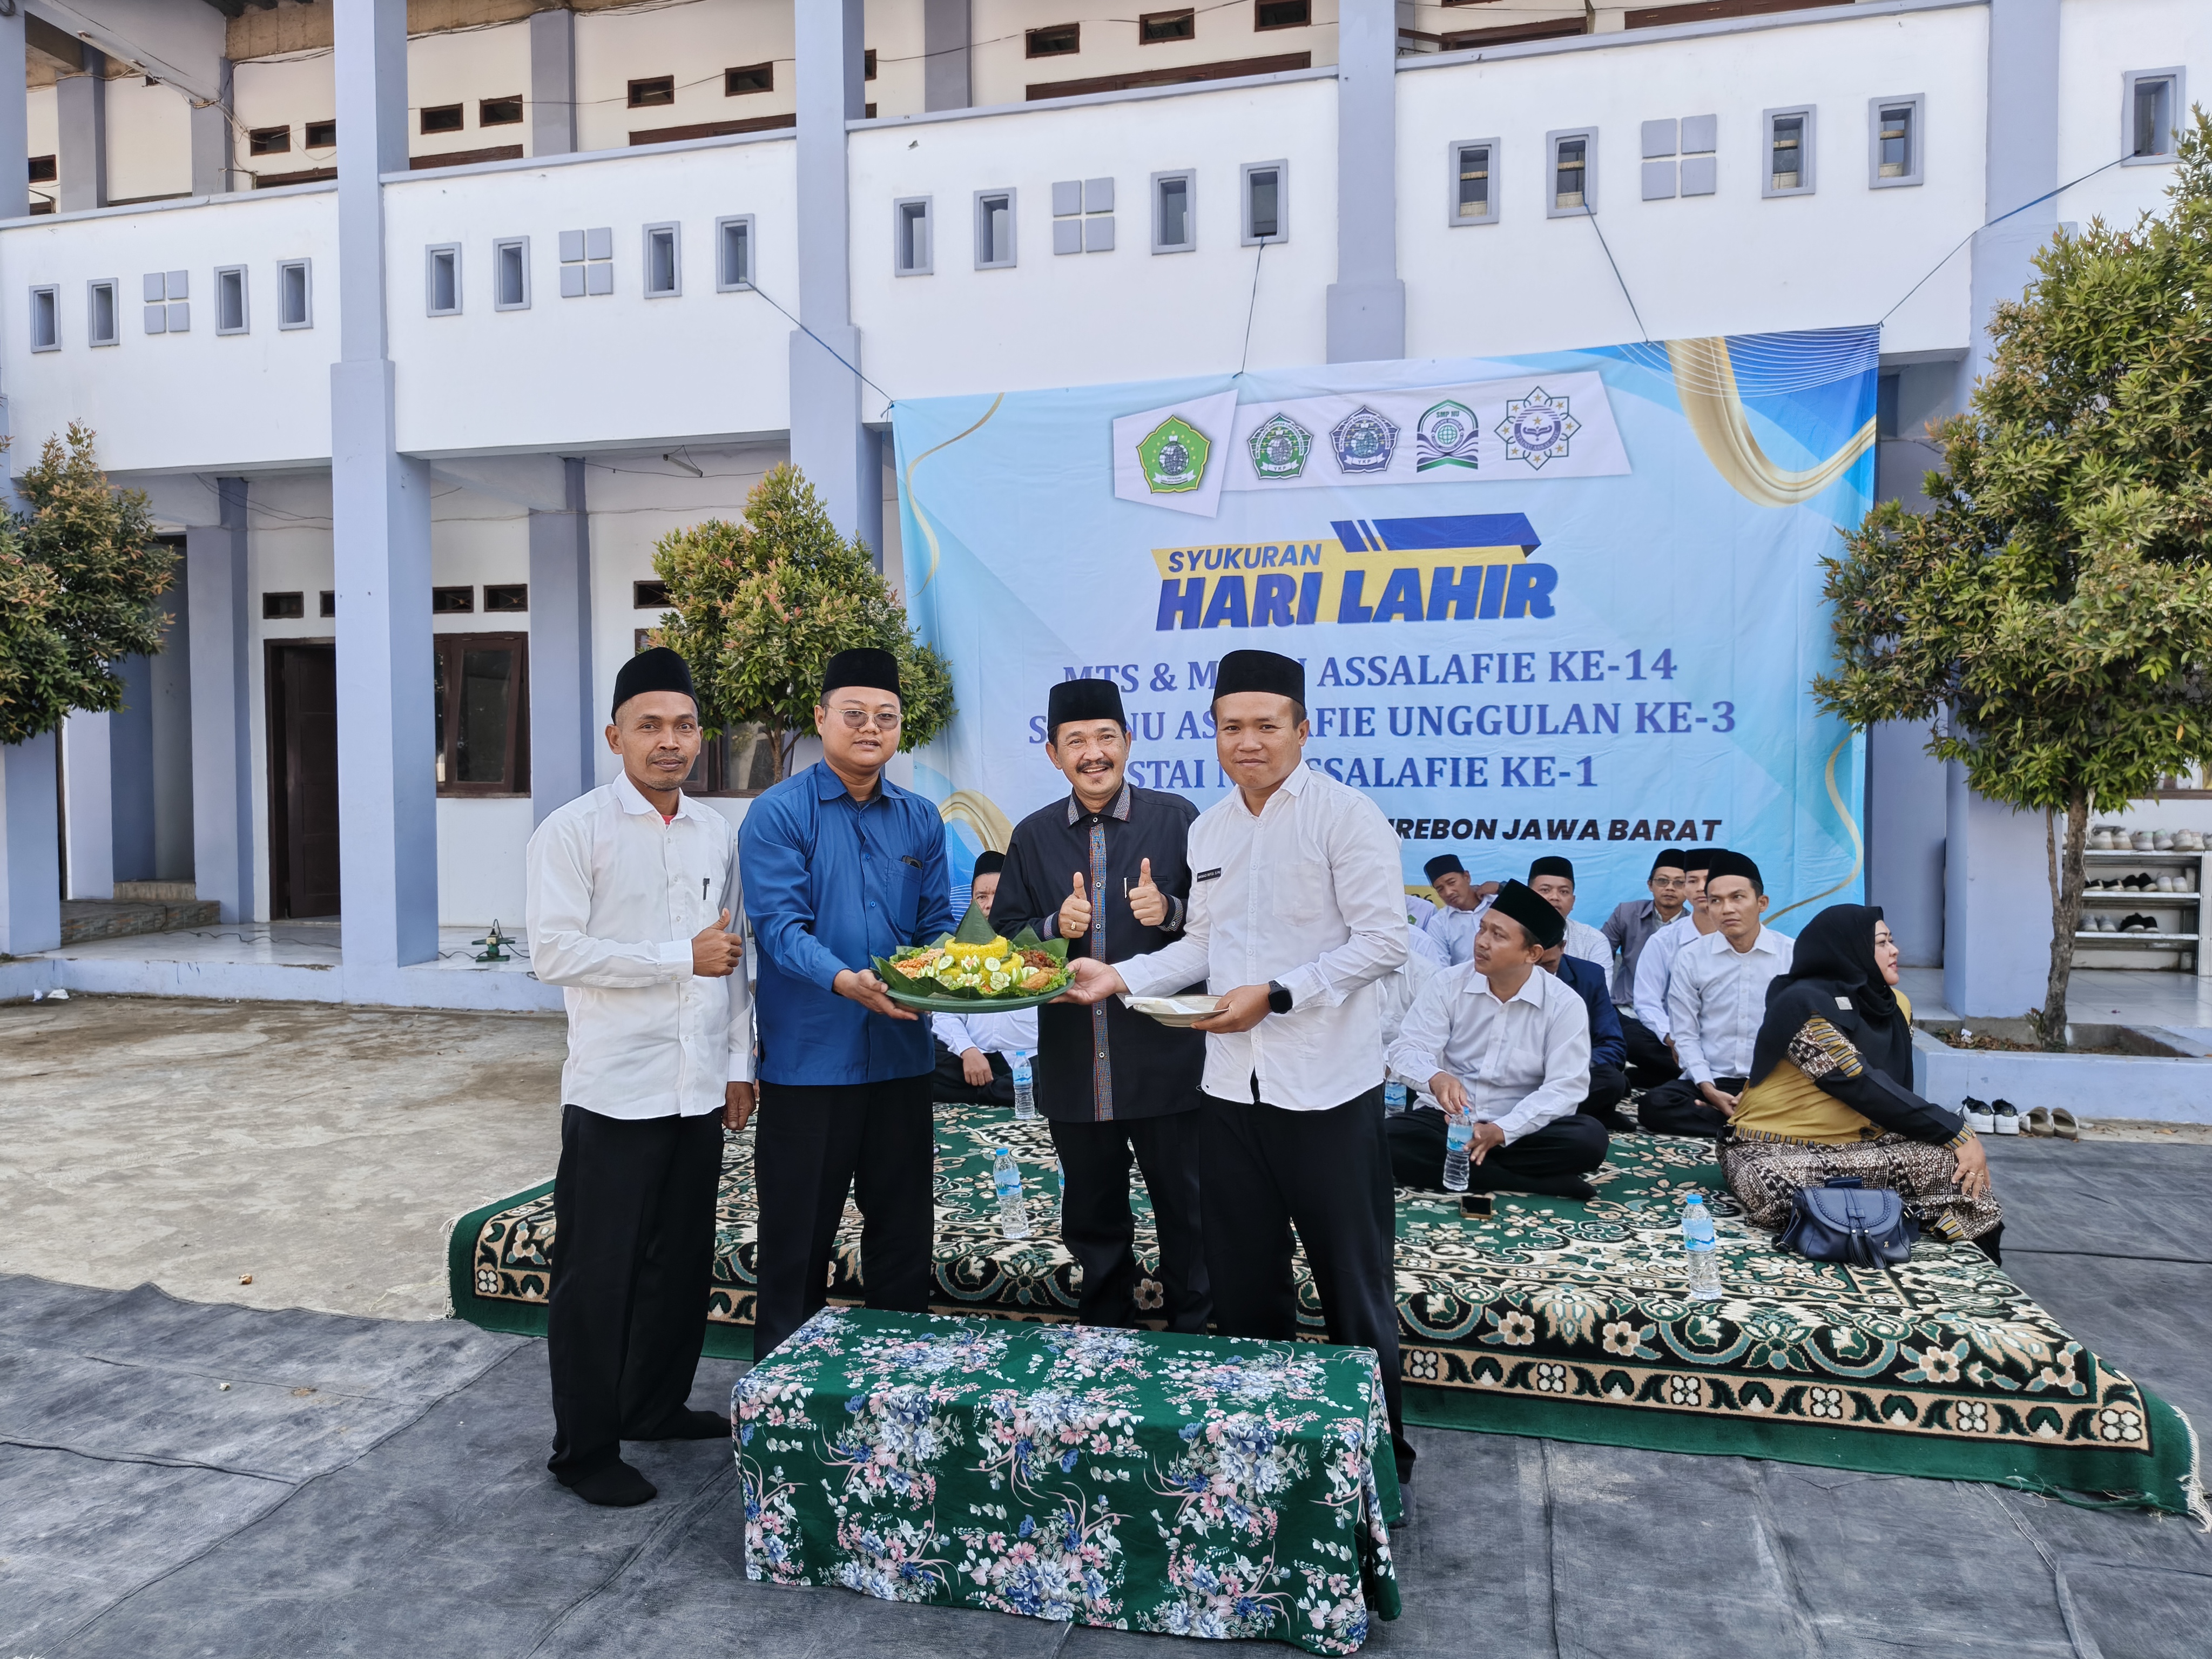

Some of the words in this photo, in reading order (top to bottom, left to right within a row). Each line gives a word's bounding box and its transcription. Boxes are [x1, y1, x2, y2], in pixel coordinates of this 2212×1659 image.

[1168, 544, 1322, 572] SYUKURAN
[1156, 571, 1323, 631] HARI
[1337, 563, 1559, 624] LAHIR
[1150, 663, 1178, 692] &
[1317, 652, 1535, 687] ASSALAFIE
[1548, 648, 1677, 682] KE-14
[1388, 703, 1620, 737] UNGGULAN
[1635, 700, 1735, 734] KE-3
[1128, 759, 1206, 789] STAI
[1501, 756, 1598, 787] KE-1
[1502, 819, 1601, 841] JAWA
[1607, 819, 1722, 842] BARAT
